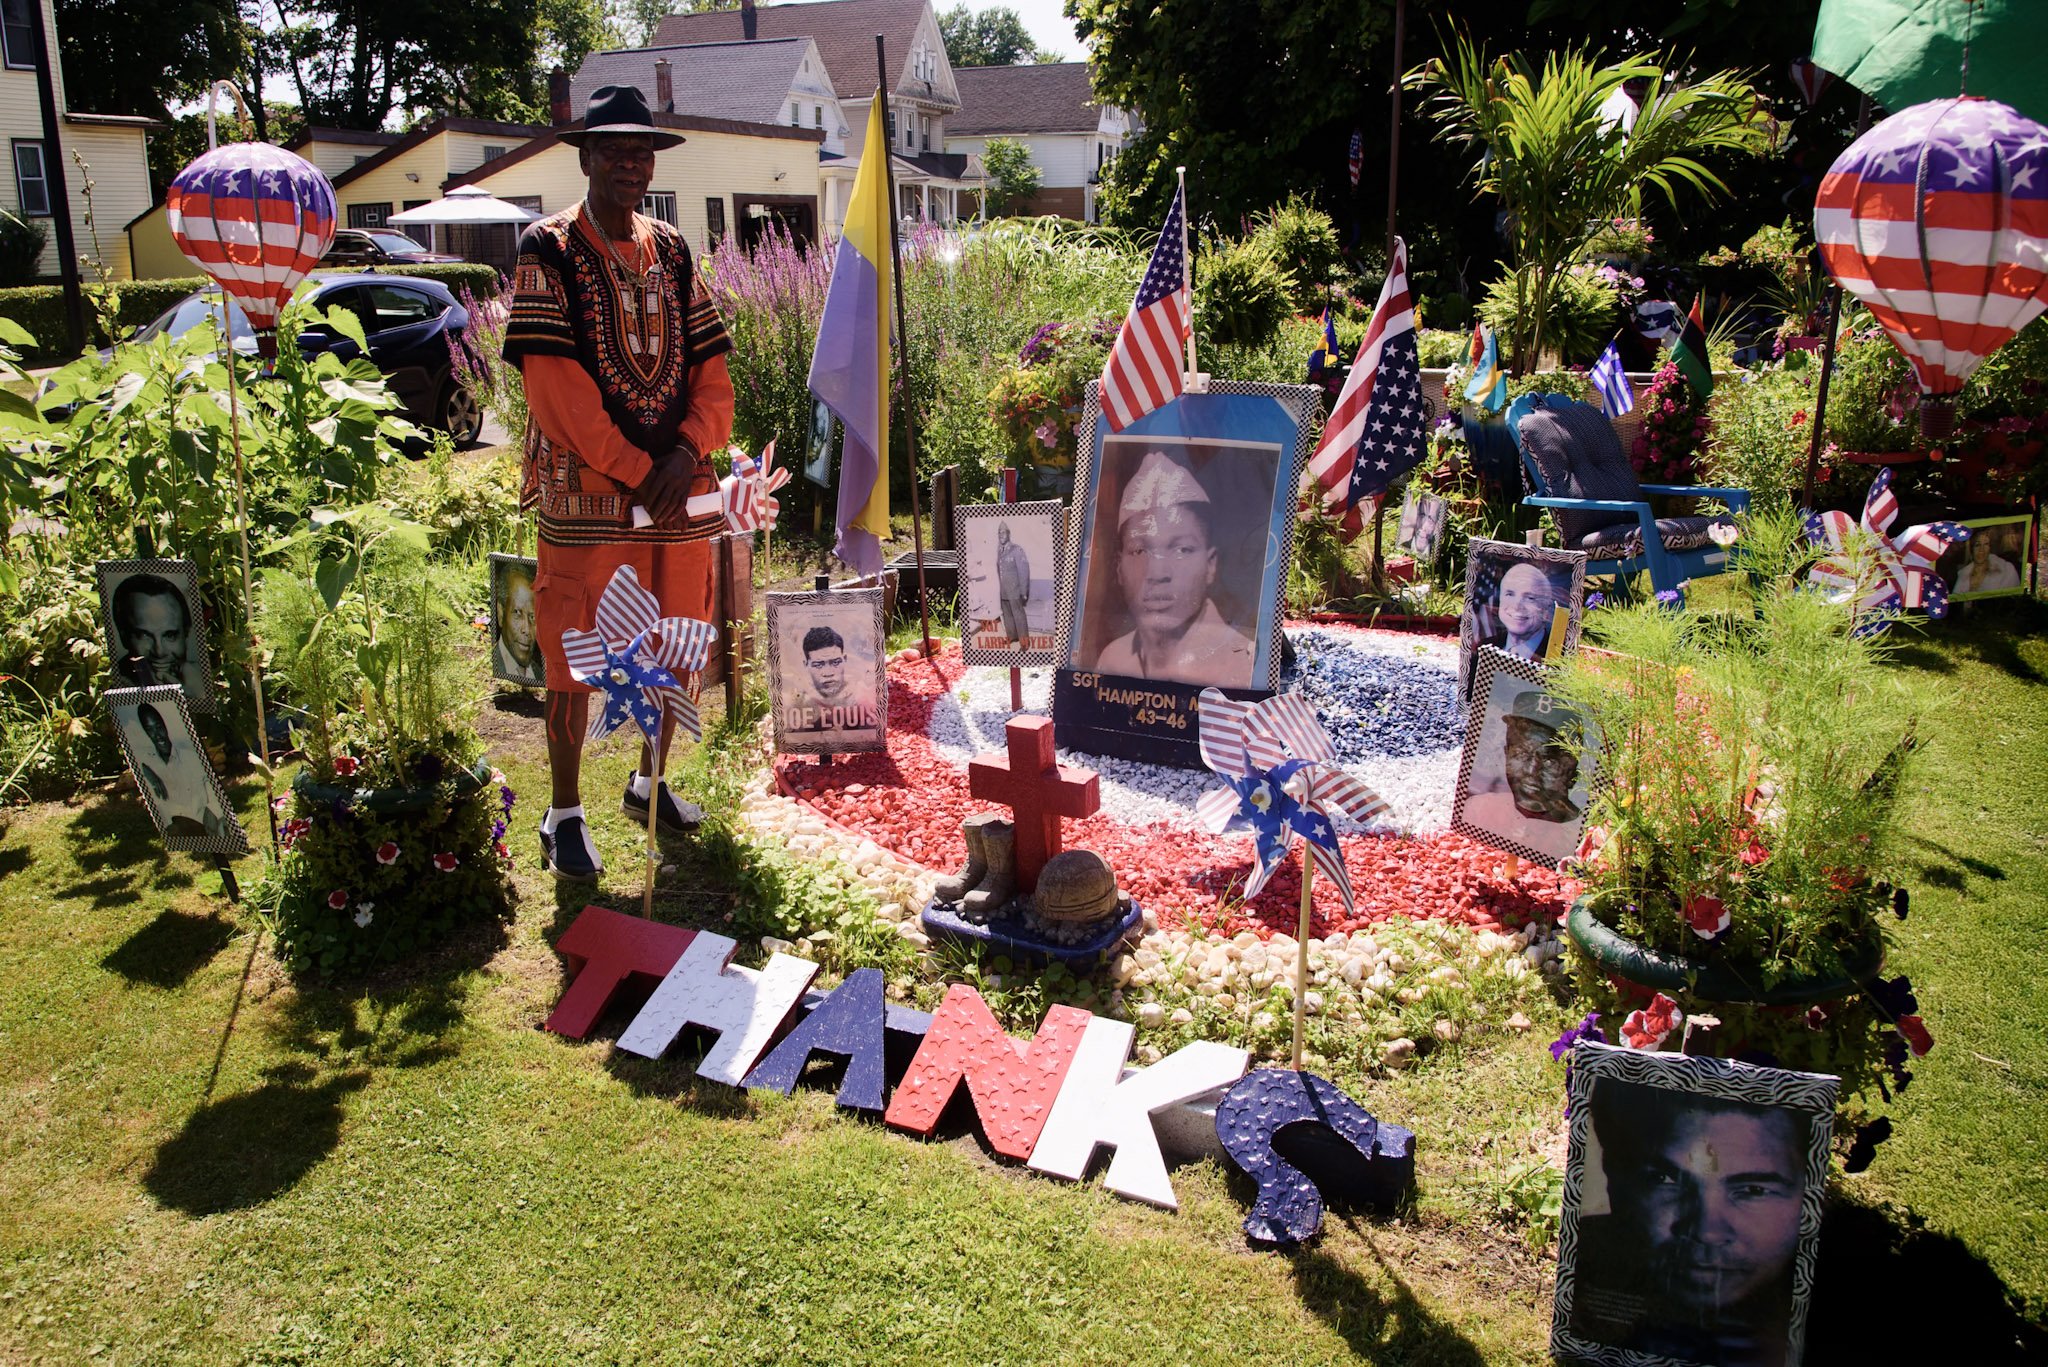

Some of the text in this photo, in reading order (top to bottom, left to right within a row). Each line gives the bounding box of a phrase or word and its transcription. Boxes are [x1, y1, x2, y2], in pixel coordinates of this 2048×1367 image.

[1072, 672, 1101, 689] SGT
[1099, 687, 1176, 710] HAMPTON
[1535, 693, 1553, 714] B
[821, 704, 877, 729] LOUIS
[1135, 708, 1187, 730] 43-46
[544, 904, 1388, 1244] THANKS
